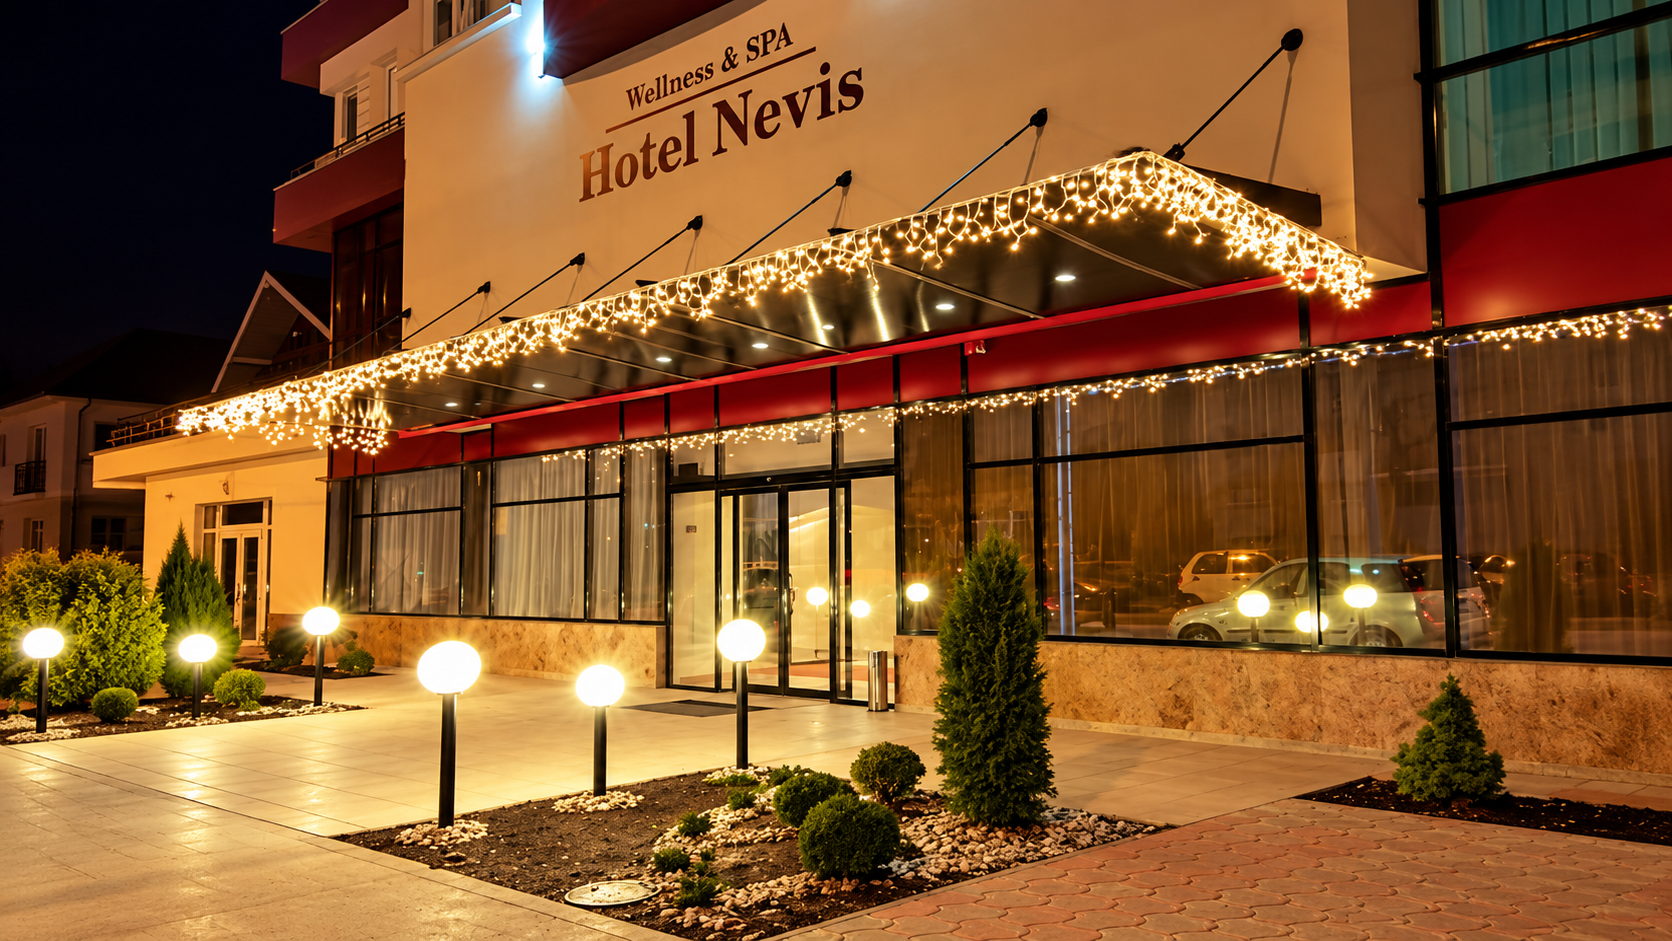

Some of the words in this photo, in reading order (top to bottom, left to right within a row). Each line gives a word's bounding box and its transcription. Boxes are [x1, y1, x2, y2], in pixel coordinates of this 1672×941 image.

[625, 62, 714, 111] Wellness
[721, 46, 739, 73] &
[746, 22, 794, 63] SPA
[579, 110, 699, 203] Hotel
[712, 61, 864, 157] Nevis
